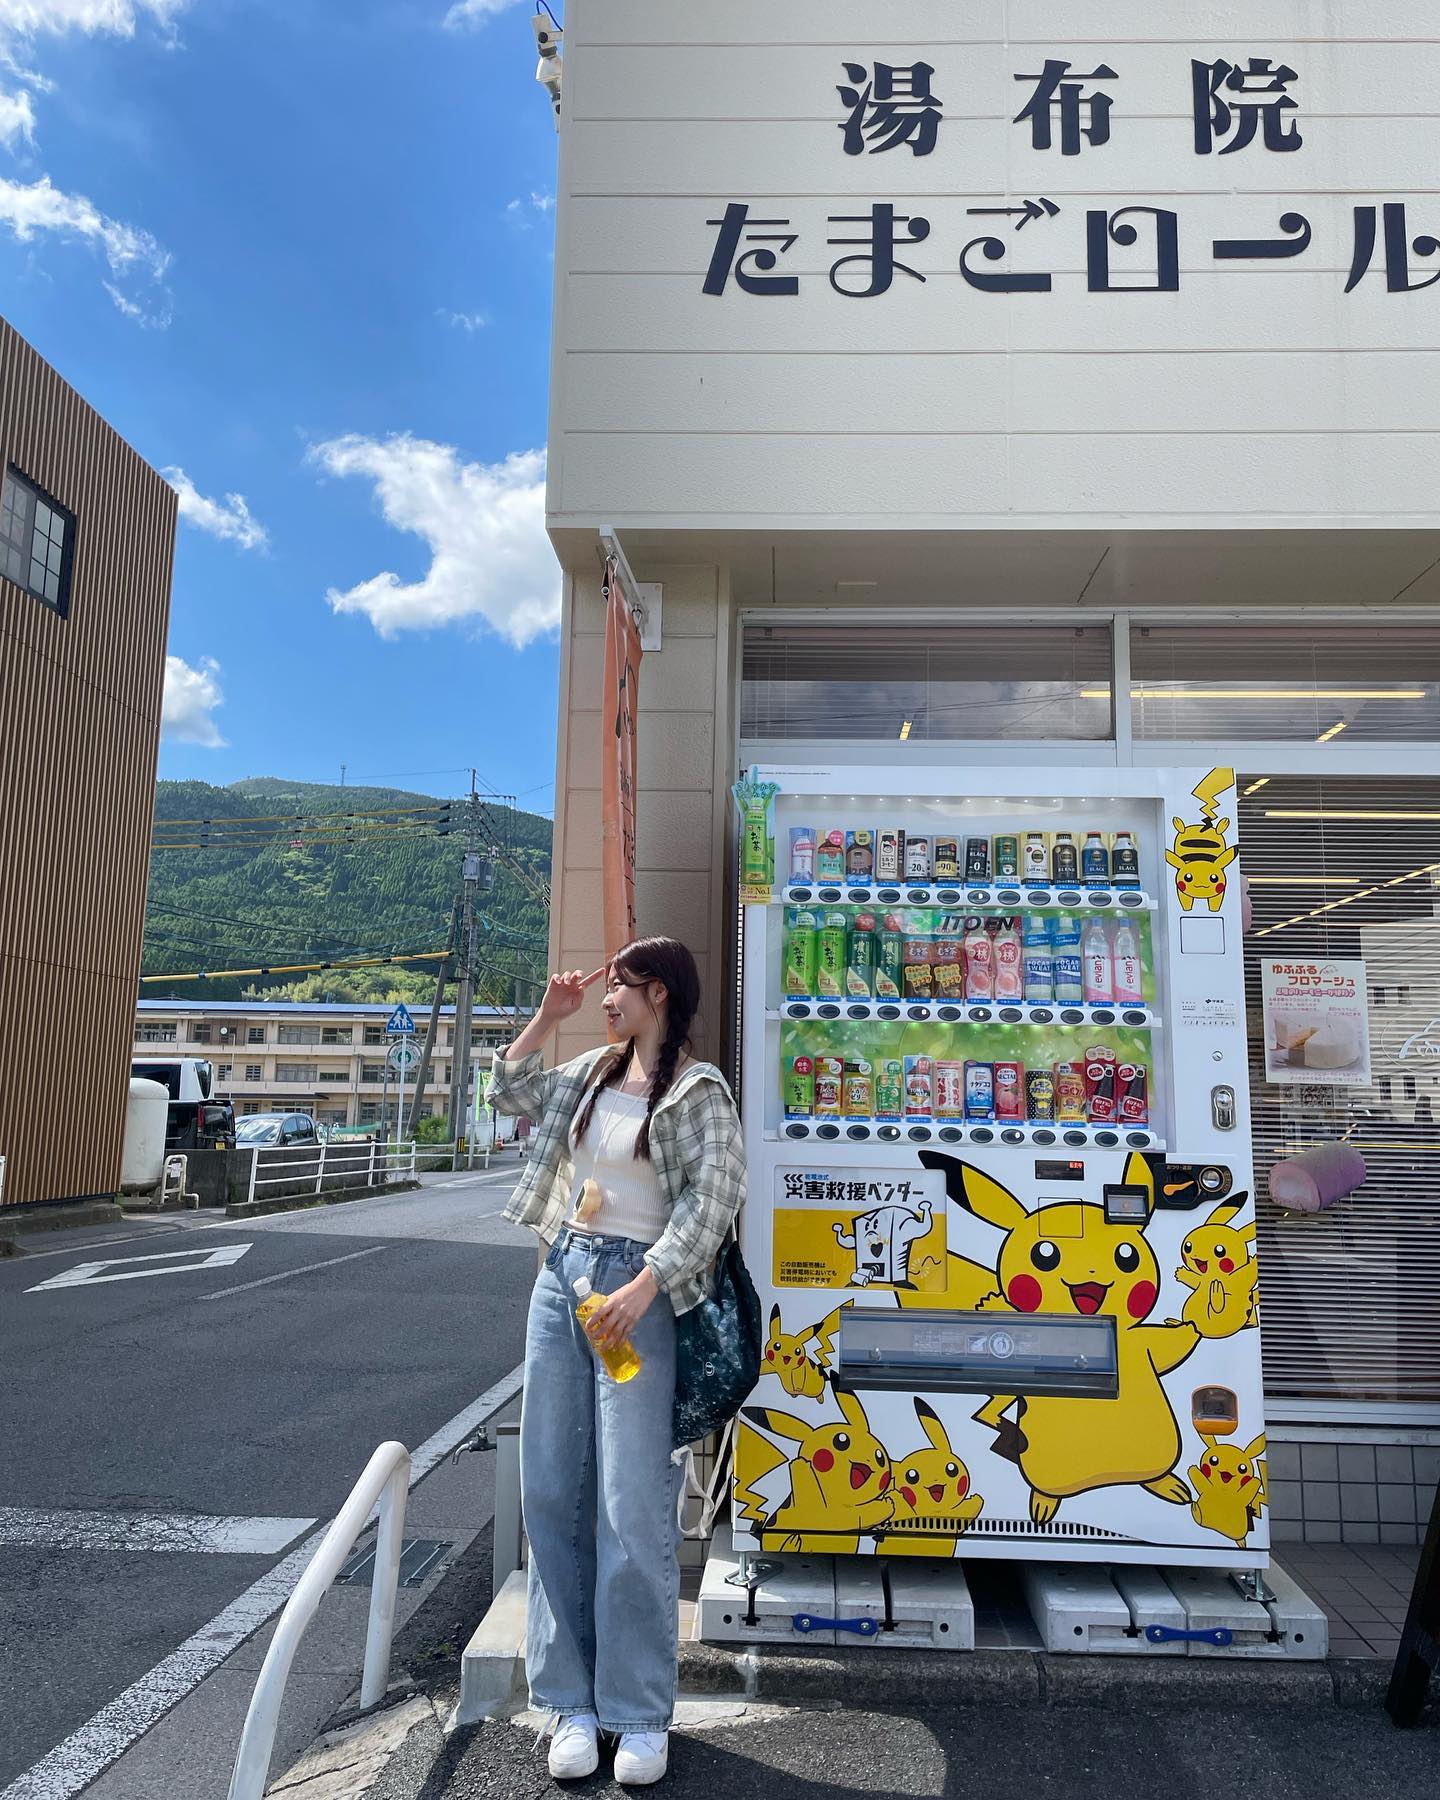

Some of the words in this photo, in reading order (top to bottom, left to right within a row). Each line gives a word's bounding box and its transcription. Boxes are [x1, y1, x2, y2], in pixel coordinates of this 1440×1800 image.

[836, 59, 1304, 156] 湯布院
[702, 198, 1440, 298] たまごロール
[942, 915, 982, 930] ITO
[983, 915, 1015, 931] EN
[1094, 960, 1103, 983] evian
[1125, 960, 1134, 984] evian
[1288, 976, 1355, 986] フロマージュ
[785, 1181, 924, 1202] 災害救援ベンダー
